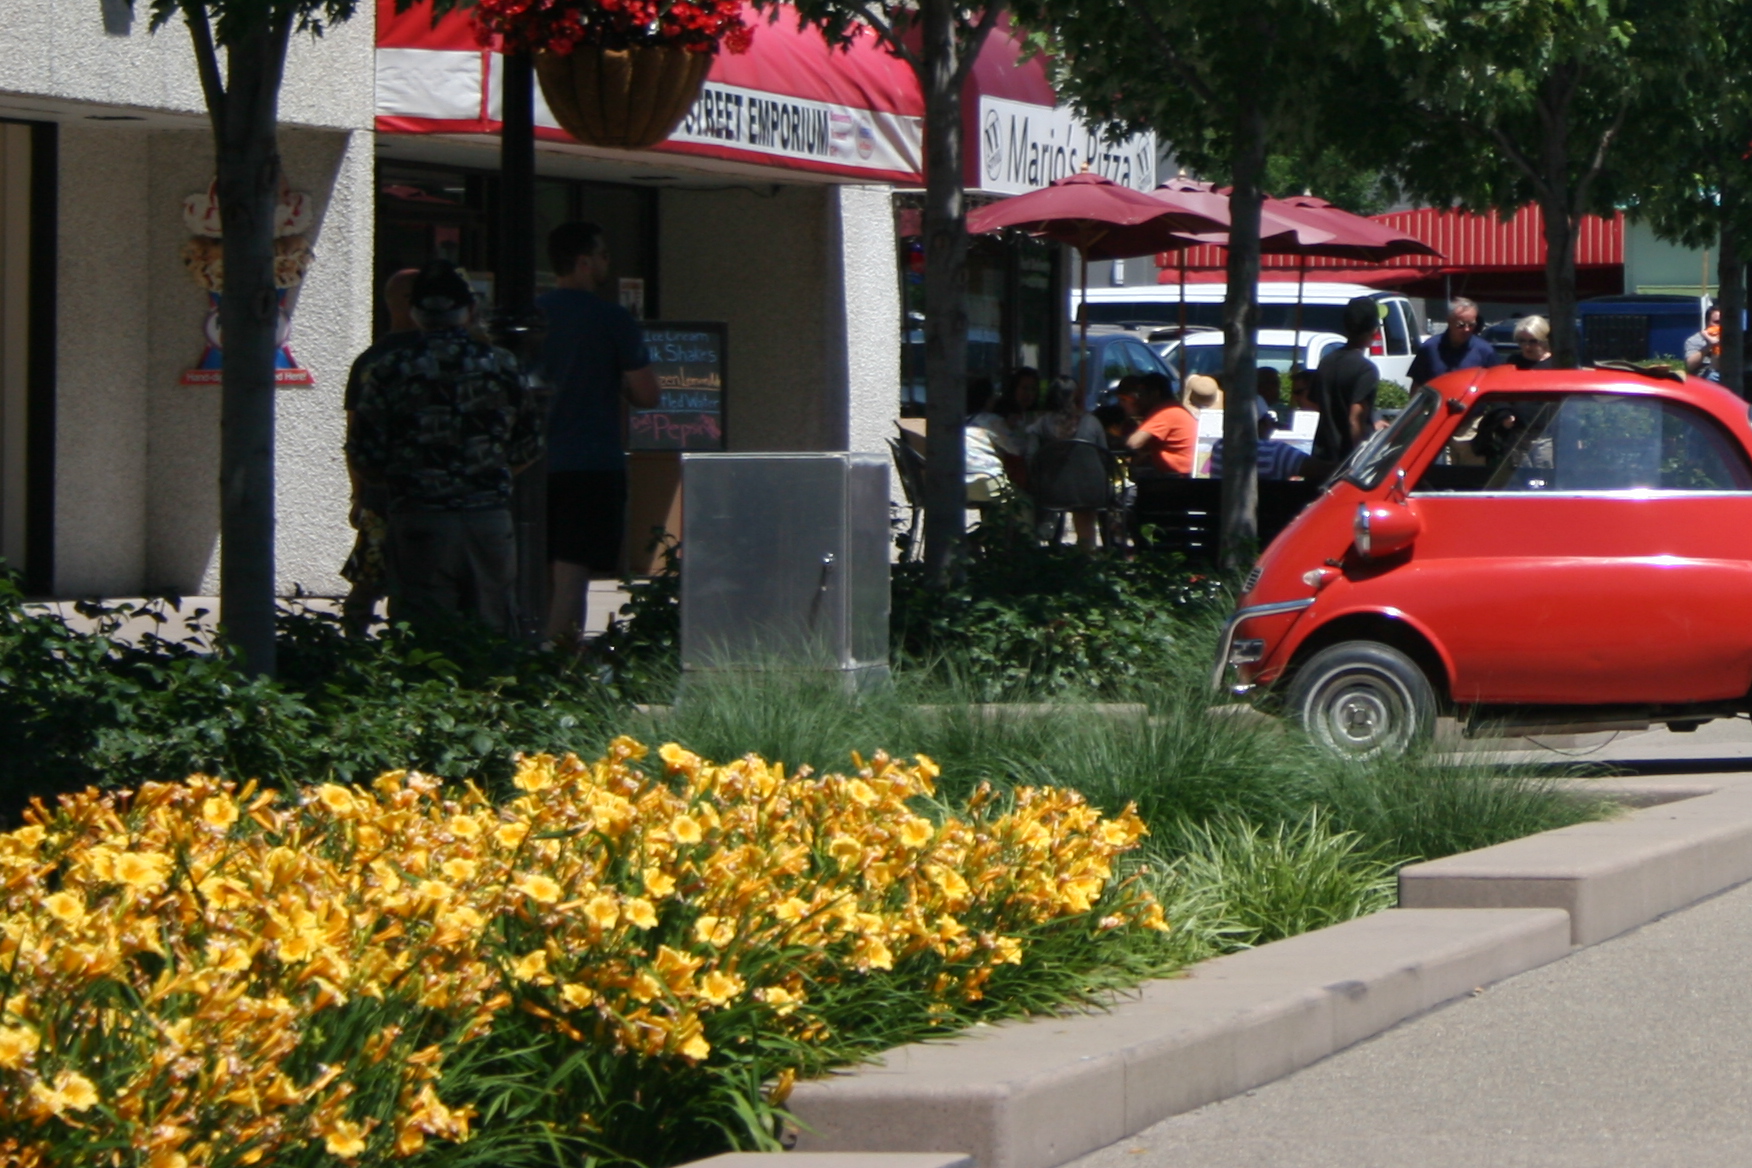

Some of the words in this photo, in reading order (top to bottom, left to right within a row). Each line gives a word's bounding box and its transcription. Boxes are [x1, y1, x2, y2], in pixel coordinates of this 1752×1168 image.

[747, 97, 831, 157] EMPORIUM
[1007, 114, 1079, 187] Mario's
[1086, 128, 1132, 189] Pizza
[665, 343, 717, 363] Shakes
